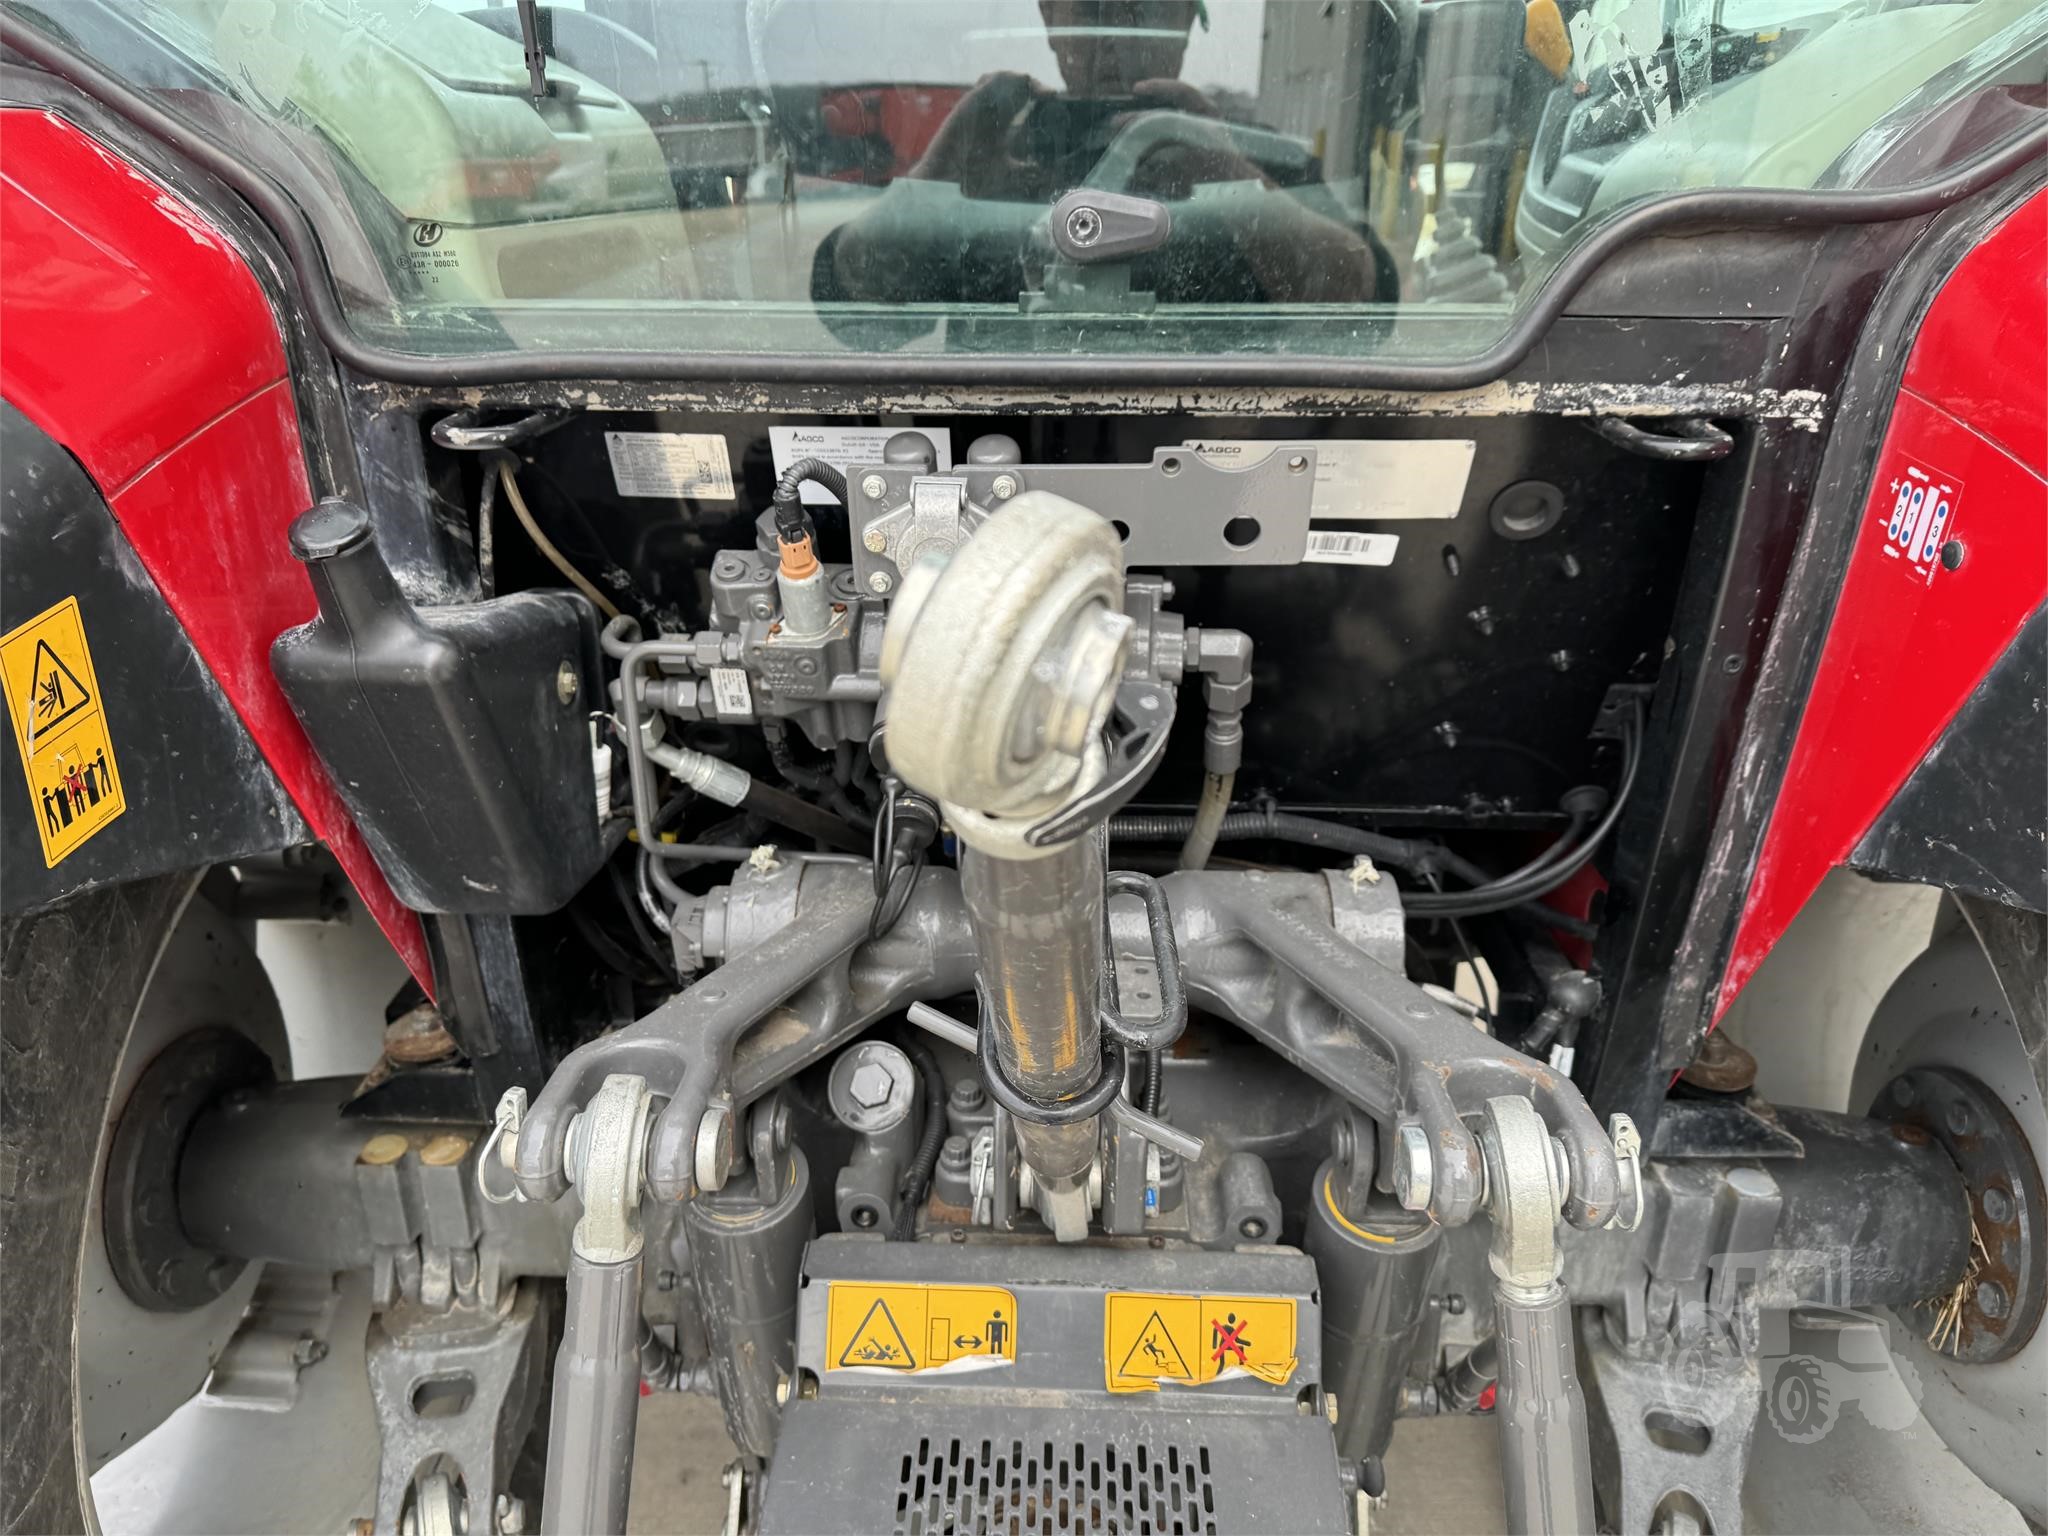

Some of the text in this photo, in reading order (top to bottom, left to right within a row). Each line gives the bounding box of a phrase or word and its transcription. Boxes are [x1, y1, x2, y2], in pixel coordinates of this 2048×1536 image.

[1206, 446, 1241, 454] AGCO
[1896, 505, 1903, 517] 2
[1909, 512, 1914, 524] 1
[1932, 525, 1939, 538] 3
